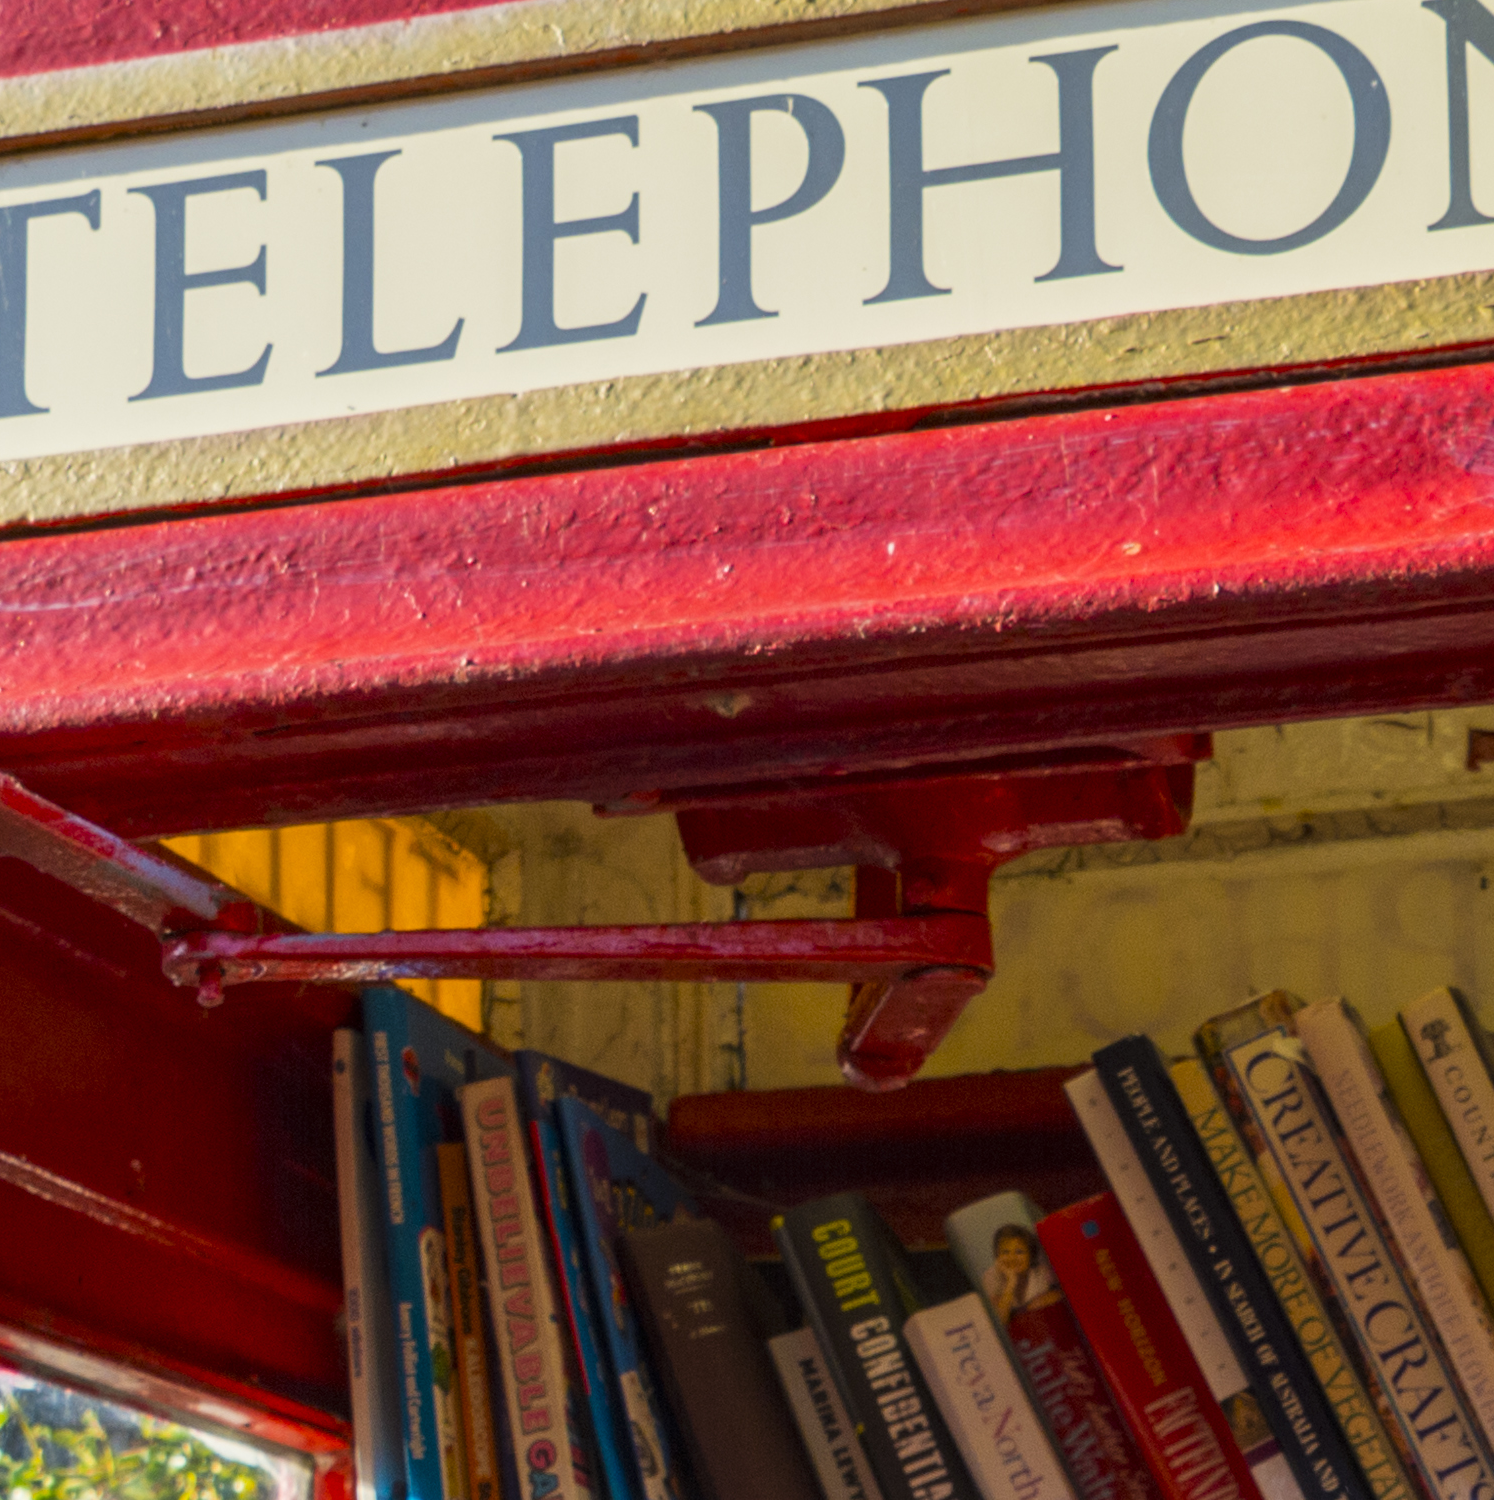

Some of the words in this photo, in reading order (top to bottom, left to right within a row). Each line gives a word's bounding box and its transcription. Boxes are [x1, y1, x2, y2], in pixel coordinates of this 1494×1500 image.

[1114, 1065, 1163, 1136] PEOPLE
[1148, 1134, 1183, 1176] AND
[1238, 1042, 1398, 1302] CREATIVE
[1168, 1172, 1216, 1243] PLACES
[1189, 1104, 1263, 1211] MAKE
[1239, 1206, 1315, 1316] MORE
[1292, 1313, 1341, 1370] OF
[476, 1100, 553, 1434] UNBELIEVABLE
[809, 1215, 880, 1317] COURT
[1211, 1258, 1237, 1284] IN
[1222, 1280, 1267, 1345] SEARCH
[795, 1356, 844, 1442] MARINA
[936, 1318, 1009, 1418] Freya
[1009, 1327, 1090, 1430] Julie
[1253, 1342, 1282, 1373] OF
[1266, 1369, 1323, 1457] AUSTRALIA
[1309, 1455, 1343, 1495] AND
